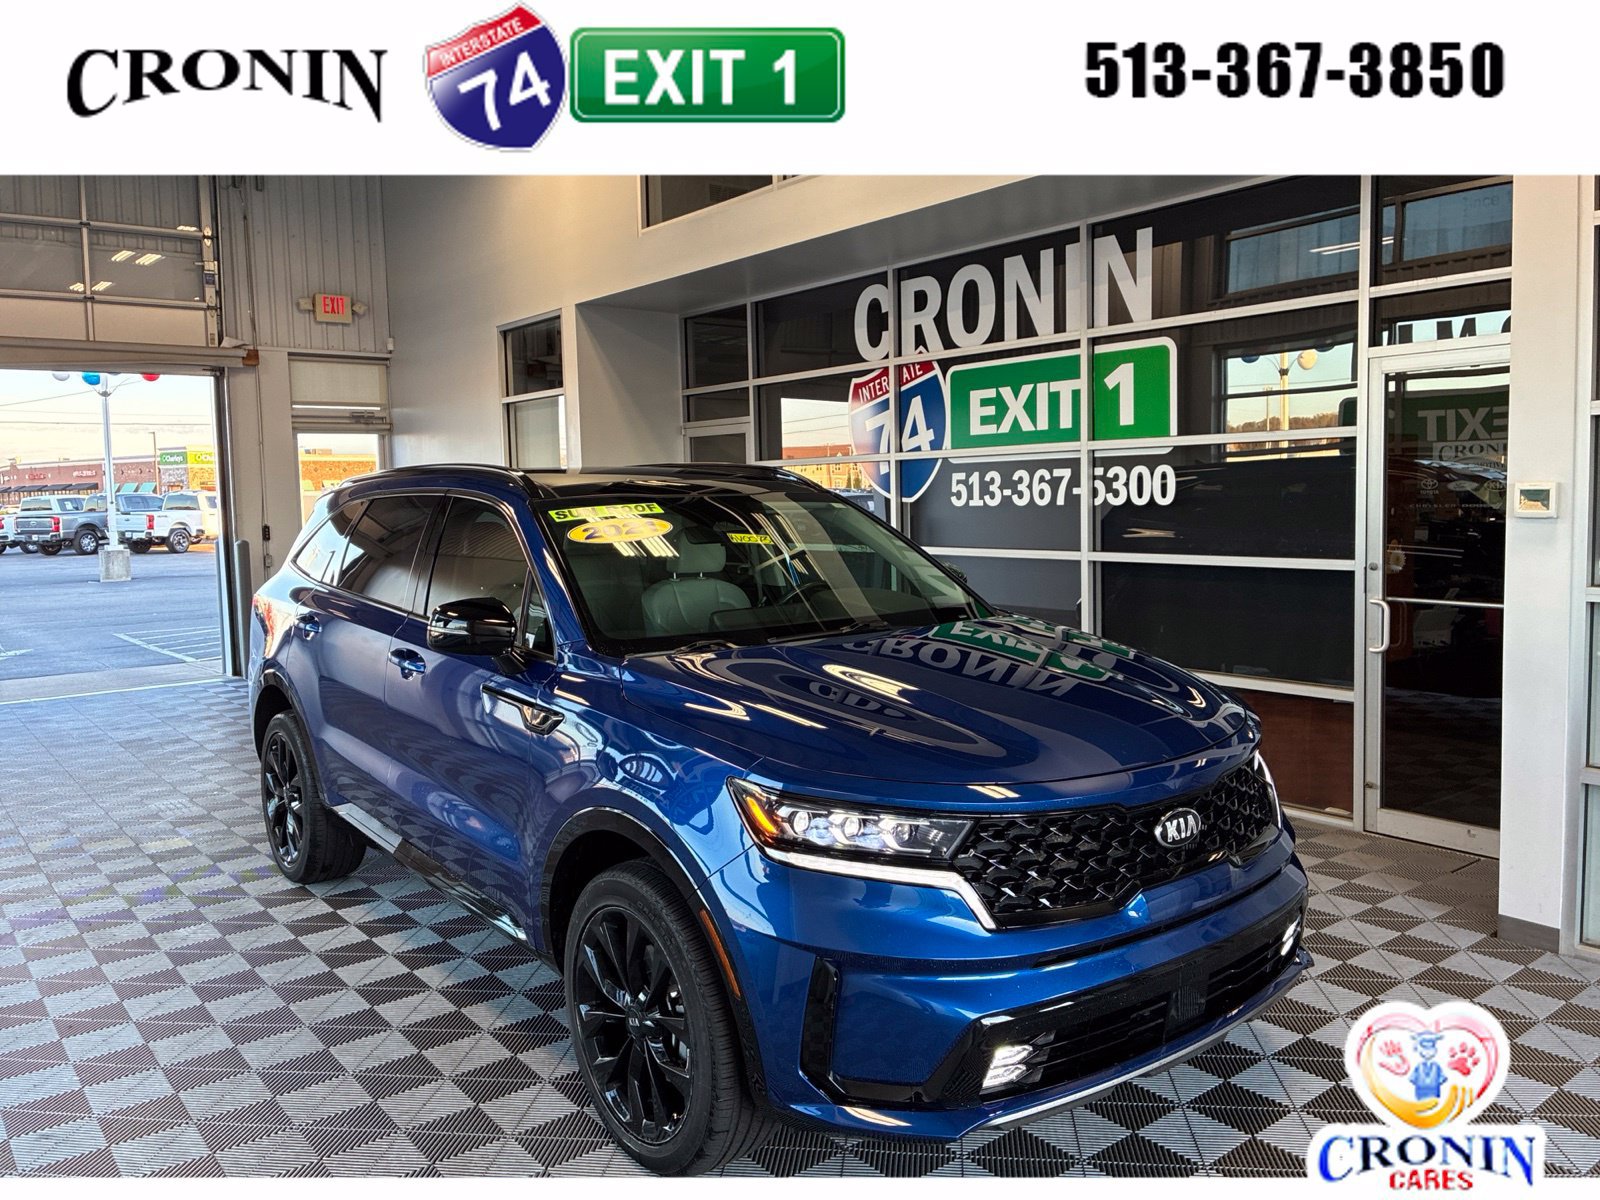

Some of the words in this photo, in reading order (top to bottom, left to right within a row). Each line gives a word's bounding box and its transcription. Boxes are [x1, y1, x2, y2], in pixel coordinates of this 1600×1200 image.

[321, 295, 346, 314] EXIT
[854, 227, 1153, 362] CRONIN
[858, 363, 923, 404] INTERATE
[969, 379, 1082, 436] EXIT
[1104, 362, 1135, 426] 1
[864, 394, 935, 475] 74
[1439, 443, 1508, 462] CRONI
[950, 464, 1176, 507] 513-367-5300
[1164, 815, 1197, 842] KIA
